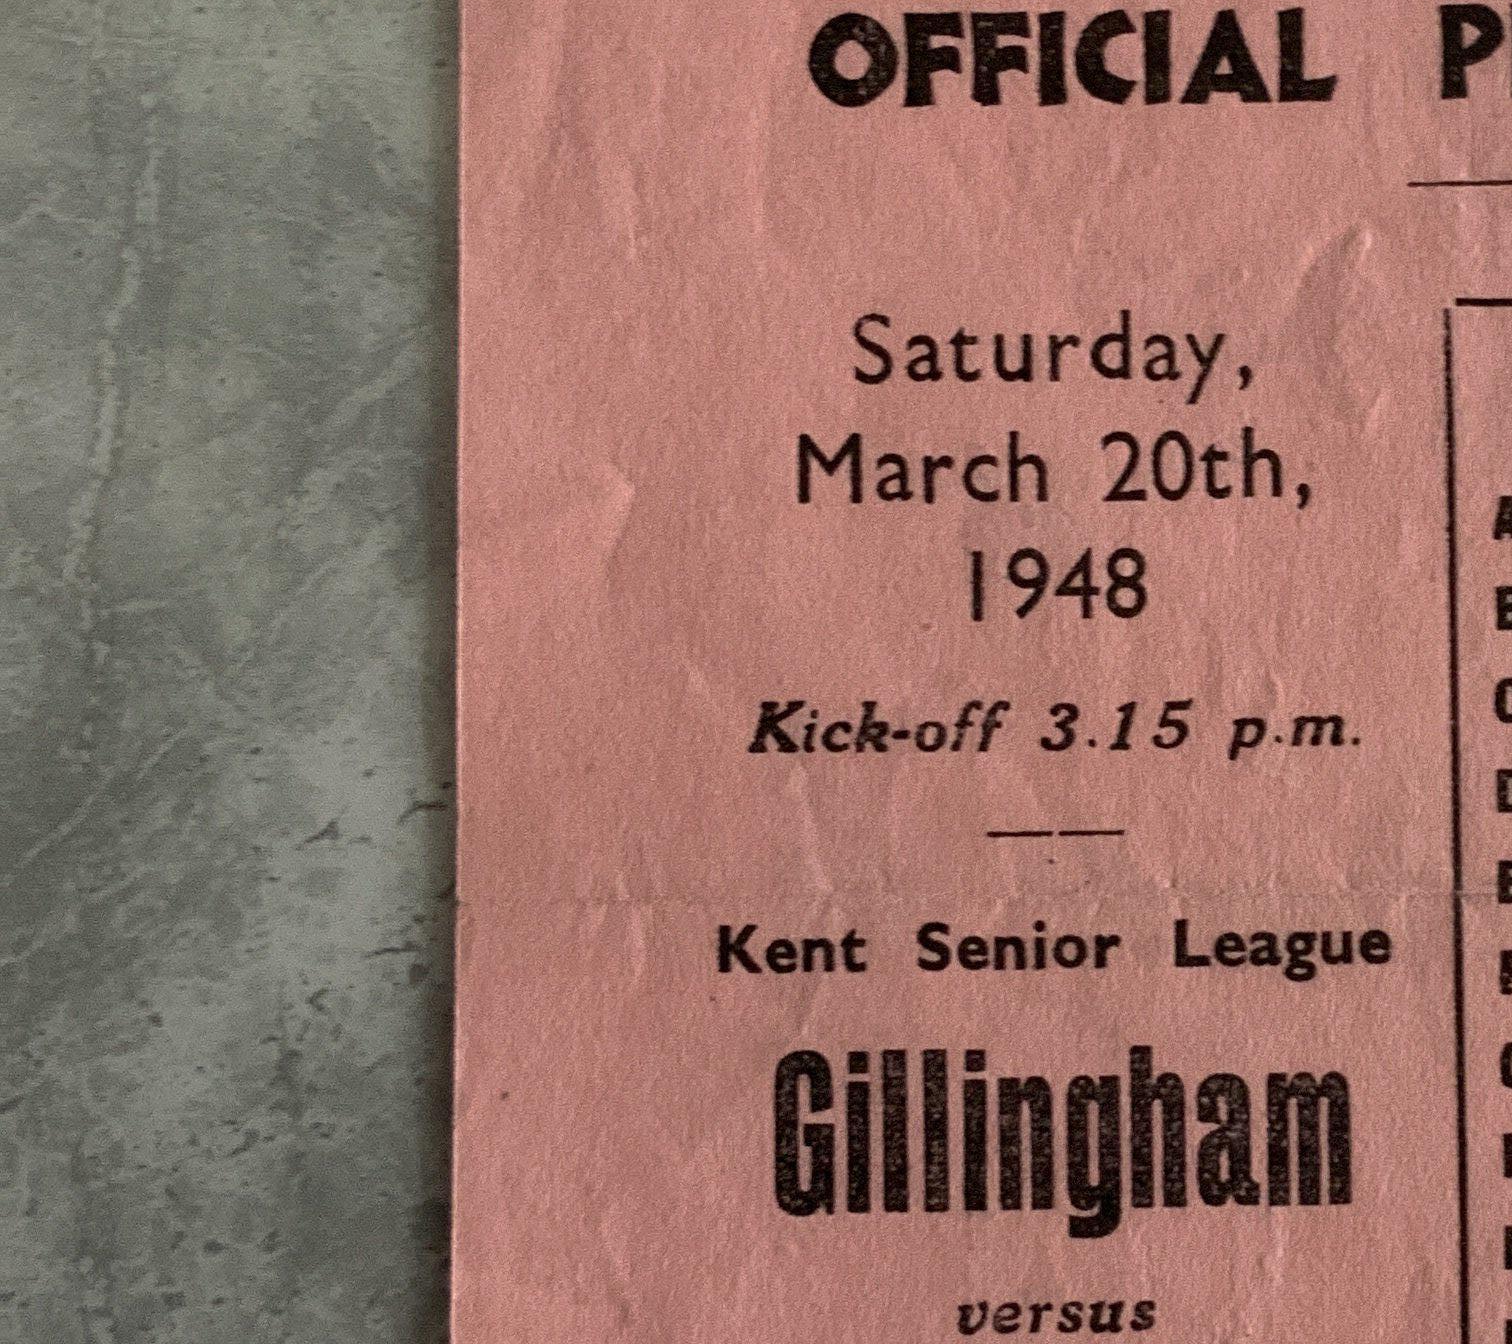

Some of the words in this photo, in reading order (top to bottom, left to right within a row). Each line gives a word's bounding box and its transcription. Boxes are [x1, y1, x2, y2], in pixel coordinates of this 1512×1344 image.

[808, 7, 1337, 107] OFFICIAL
[854, 310, 1252, 404] Saturday,
[798, 431, 1048, 504] March
[1102, 426, 1311, 509] 20th,
[971, 548, 1147, 622] 1948
[748, 700, 1010, 753] Kick-off
[1040, 699, 1193, 752] 3.15
[1229, 715, 1360, 761] p.m.
[717, 924, 867, 974] Kent
[917, 920, 1121, 971] Senior
[1174, 919, 1392, 982] League
[774, 1045, 1352, 1239] Gillingham
[958, 1301, 1155, 1335] versus
